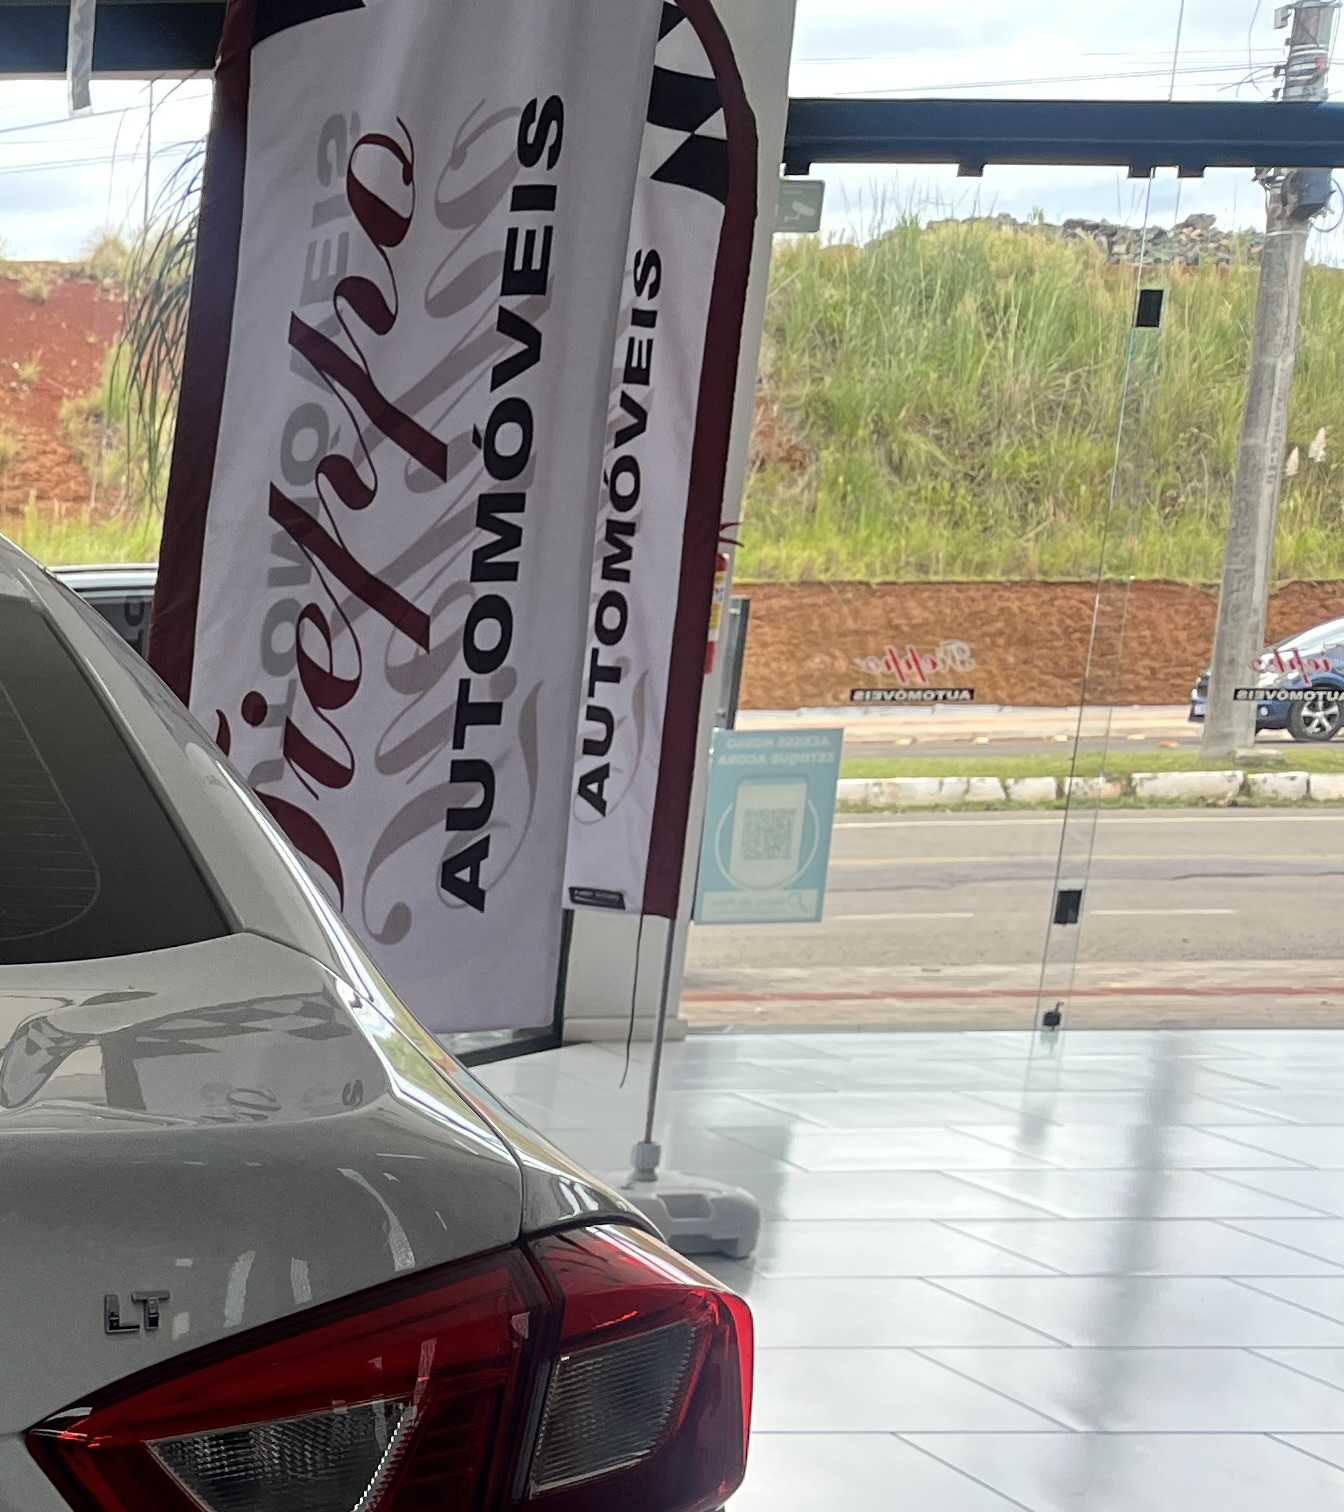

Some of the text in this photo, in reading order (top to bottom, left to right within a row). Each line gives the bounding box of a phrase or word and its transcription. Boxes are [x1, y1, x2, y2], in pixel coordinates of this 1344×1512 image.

[440, 94, 565, 913] AUTOMÓVEIS
[577, 248, 662, 817] AUTOMÓVEIS
[104, 1291, 170, 1334] LT
